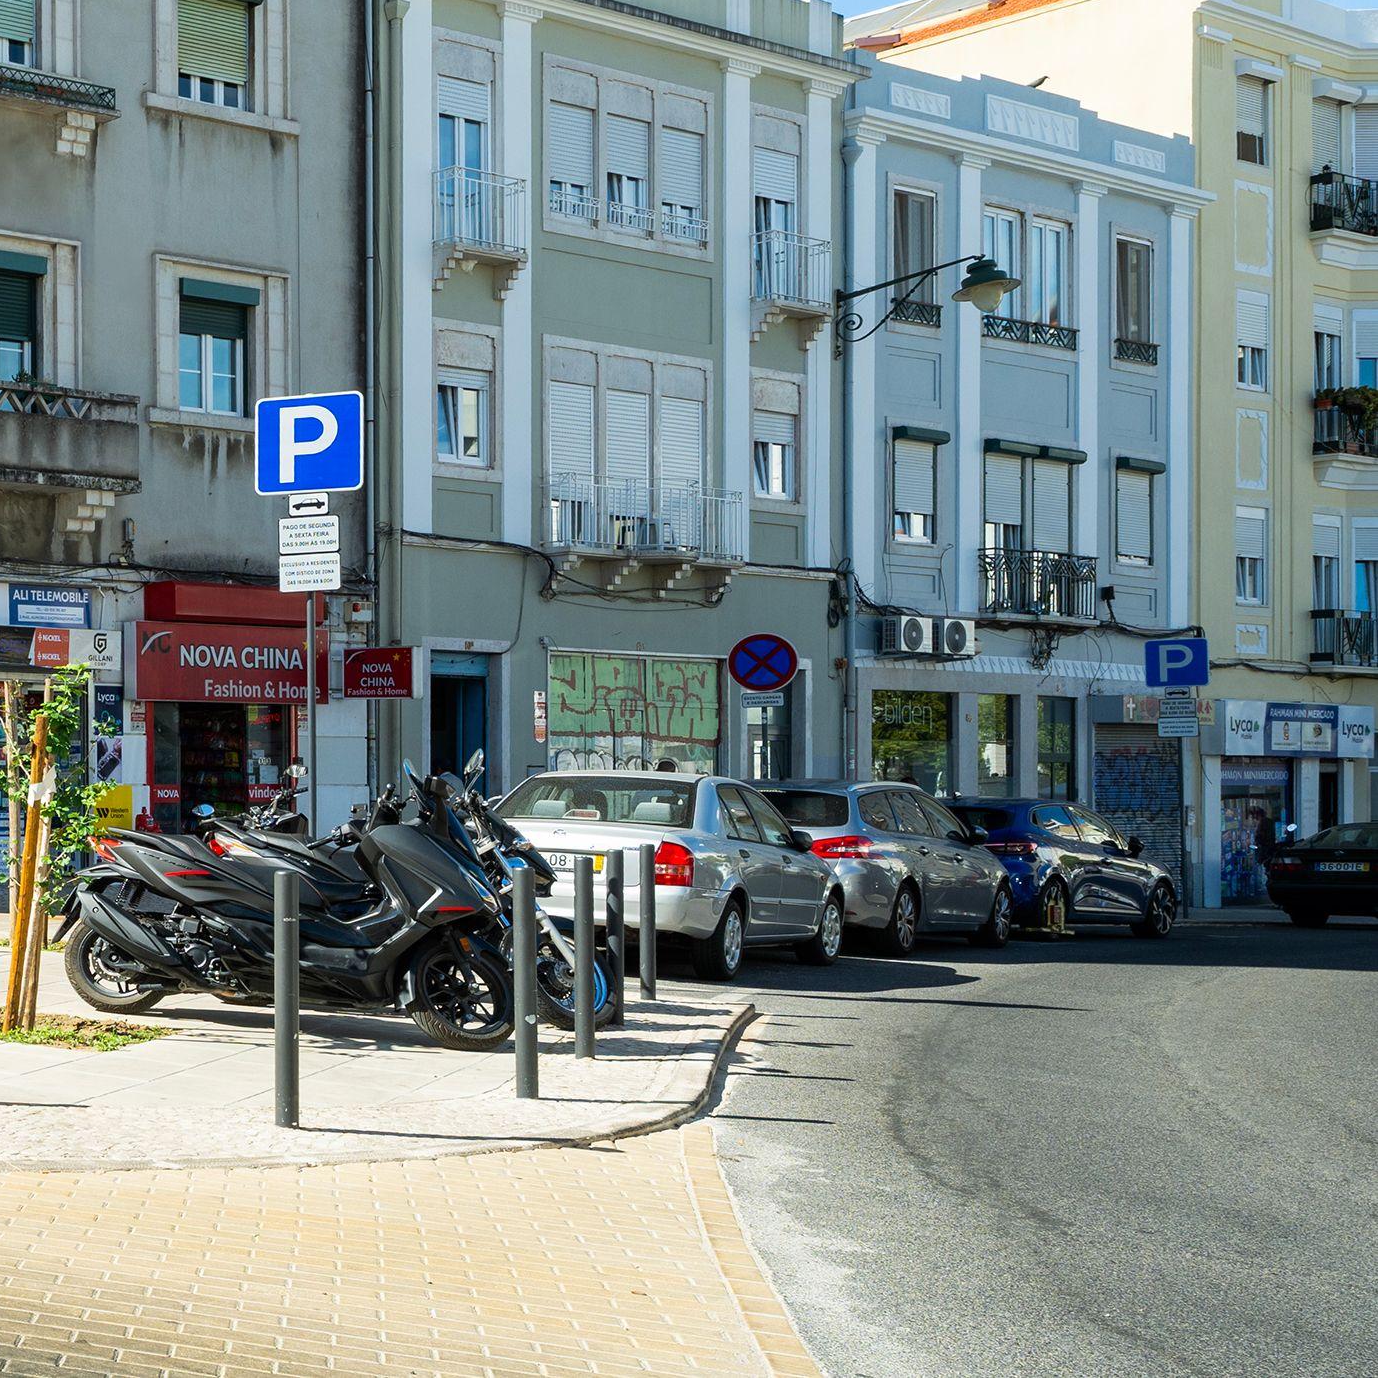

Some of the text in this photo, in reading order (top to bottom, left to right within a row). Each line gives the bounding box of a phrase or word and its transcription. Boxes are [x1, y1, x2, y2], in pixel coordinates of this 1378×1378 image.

[278, 405, 339, 484] P
[13, 590, 89, 604] ALI TELEMOBILE
[88, 654, 113, 662] GILLANI
[180, 644, 304, 670] NOVA CHINA
[362, 663, 393, 673] NOVA
[1158, 644, 1194, 683] P
[360, 677, 395, 687] CHINA
[204, 679, 262, 699] Fashion
[264, 681, 276, 699] &
[347, 688, 376, 696] Fashion
[97, 692, 115, 703] Lyca
[1269, 708, 1335, 719] RAHMAN MINI MERCADO
[1230, 716, 1253, 734] Lyca
[1342, 721, 1364, 739] Lyca
[157, 789, 180, 798] NOVA
